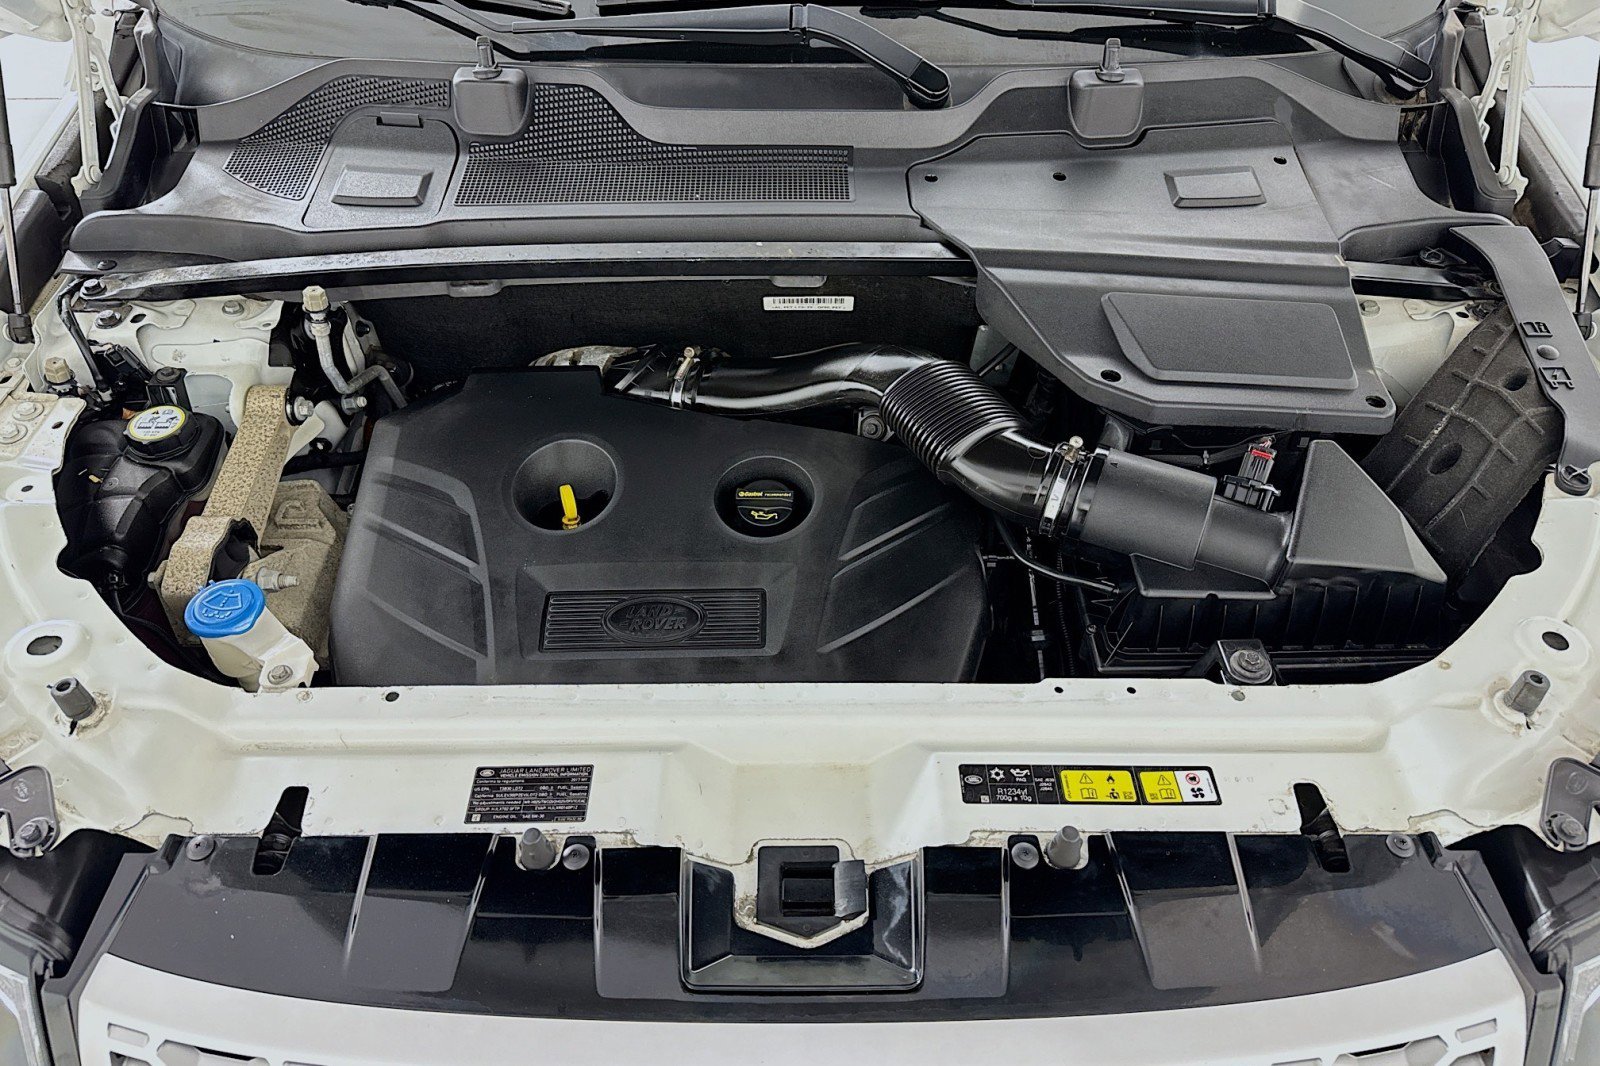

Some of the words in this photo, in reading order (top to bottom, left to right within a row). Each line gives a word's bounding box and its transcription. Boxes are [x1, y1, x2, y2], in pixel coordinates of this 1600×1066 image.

[625, 605, 673, 619] LAND
[629, 617, 687, 631] ROVER
[997, 787, 1028, 796] R1234yf
